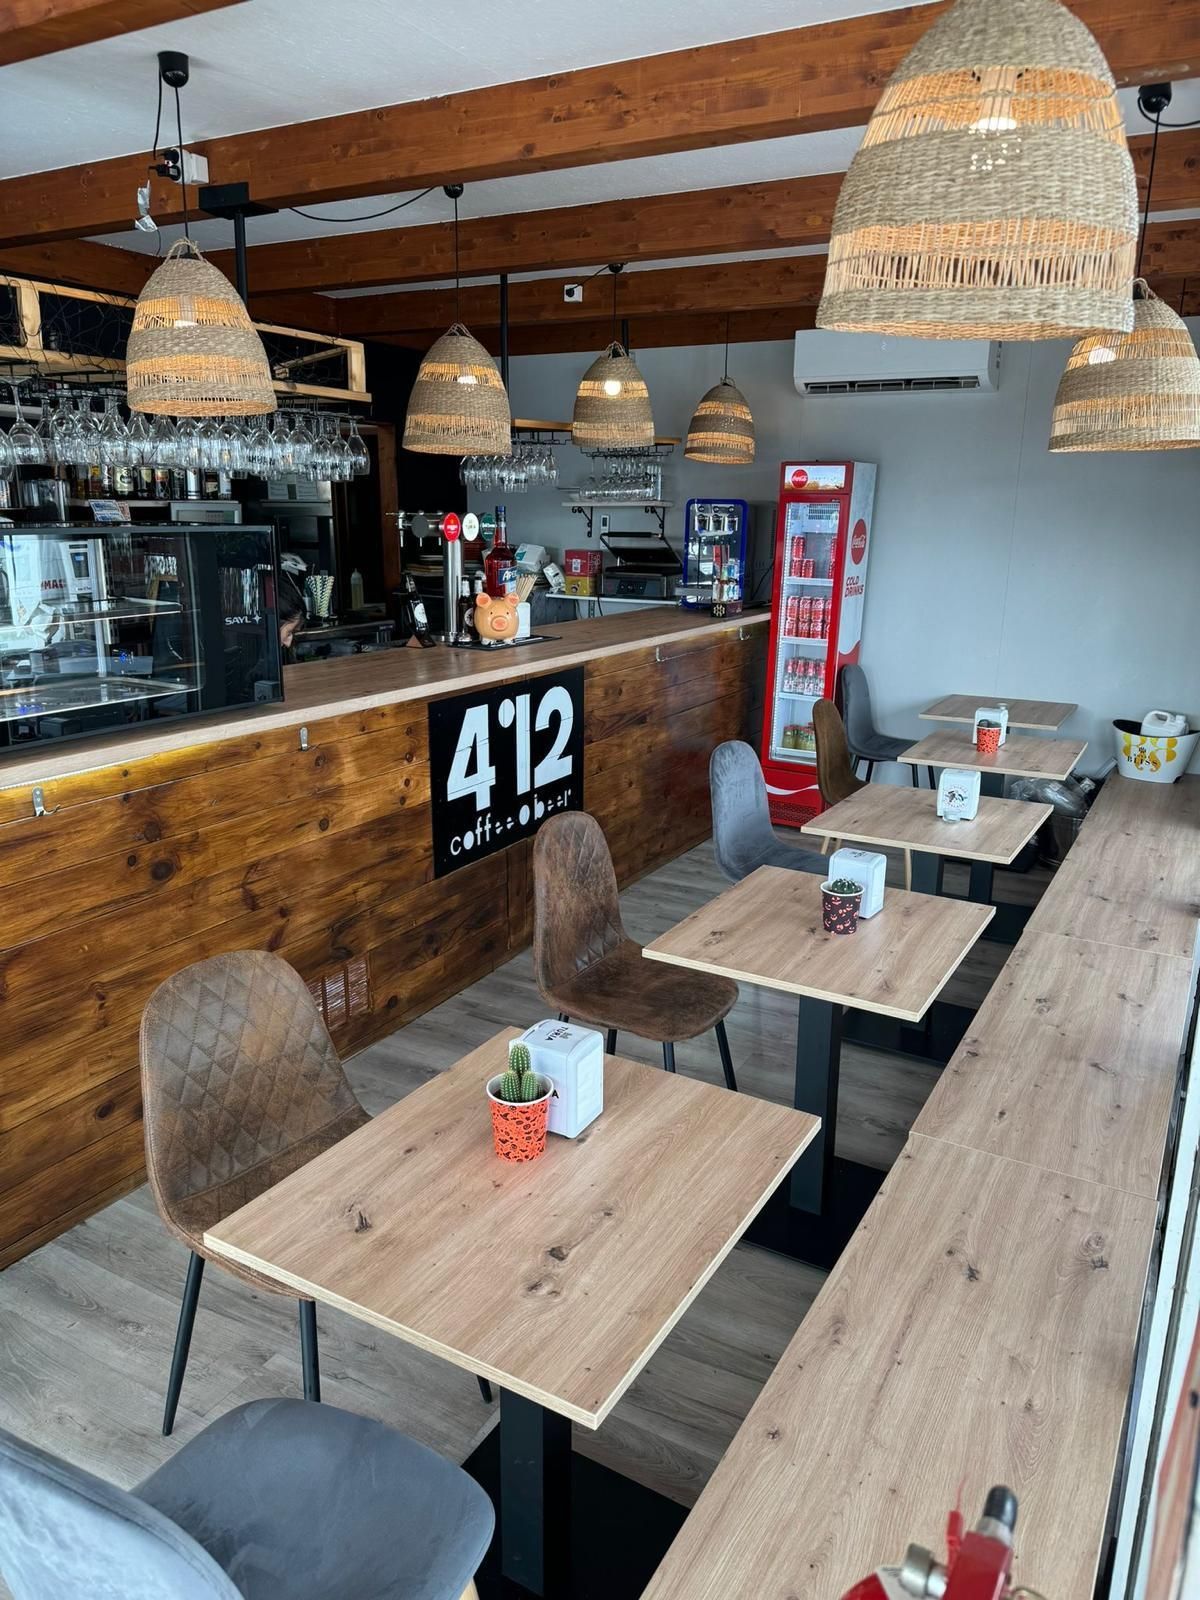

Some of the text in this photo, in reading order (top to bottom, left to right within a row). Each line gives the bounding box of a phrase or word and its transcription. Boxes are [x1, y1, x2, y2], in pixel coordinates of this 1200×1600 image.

[846, 575, 859, 587] COLD
[844, 584, 864, 598] DRINKS
[224, 615, 252, 626] SAYL
